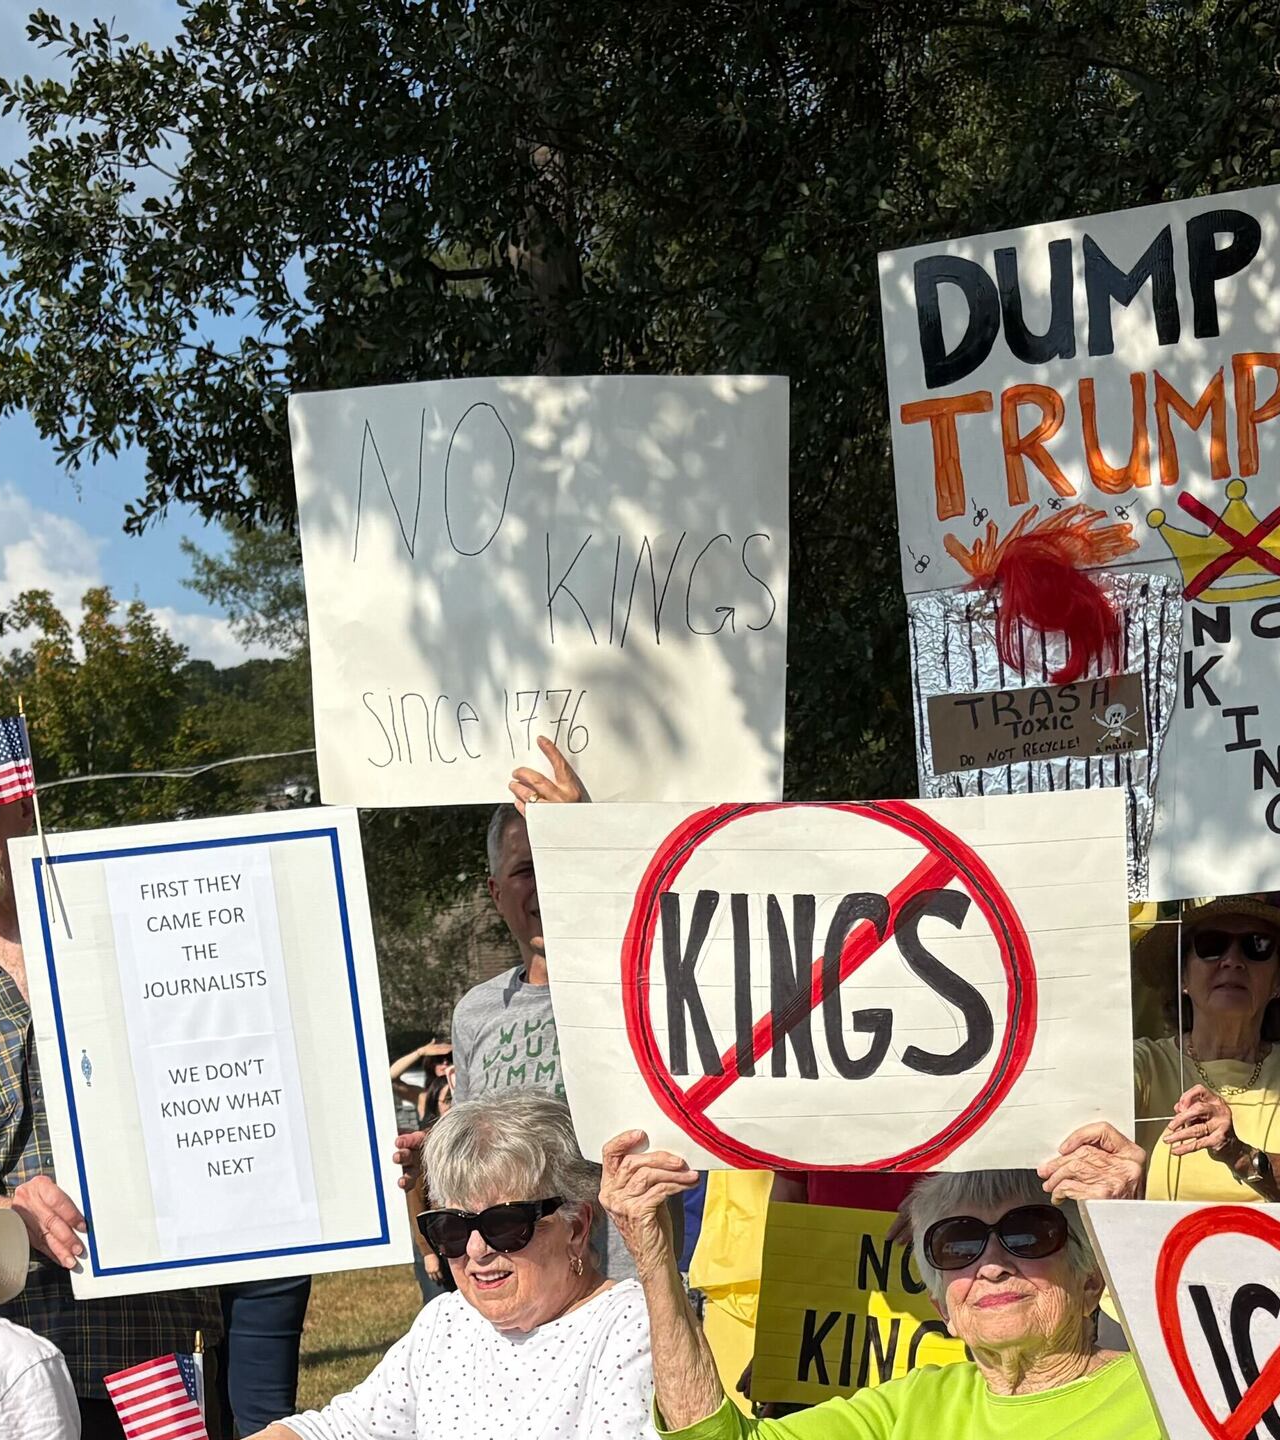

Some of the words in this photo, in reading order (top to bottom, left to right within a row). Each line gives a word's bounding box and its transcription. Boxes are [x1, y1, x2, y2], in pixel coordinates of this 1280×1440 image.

[913, 209, 1262, 389] DUMP
[353, 402, 515, 562] NO
[546, 531, 776, 648] KINGS
[954, 677, 1110, 730] TRASH
[503, 689, 590, 759] 1776
[1003, 715, 1075, 739] TOXIC
[960, 753, 975, 768] DO
[987, 748, 1016, 763] NOT
[1023, 736, 1081, 757] RECYCLE!
[140, 879, 189, 901] FIRST
[194, 873, 241, 895] THEY
[146, 911, 203, 933] CAME
[208, 906, 246, 926] FOR
[181, 942, 219, 962] THE
[143, 970, 268, 1000] JOURNALISTS
[658, 887, 996, 1082] KINGS
[168, 1066, 200, 1085] WE
[205, 1058, 265, 1082] DON'T
[161, 1096, 220, 1119] KNOW
[226, 1089, 283, 1110] WHAT
[176, 1122, 277, 1149] HAPPENED
[207, 1156, 255, 1178] NEXT
